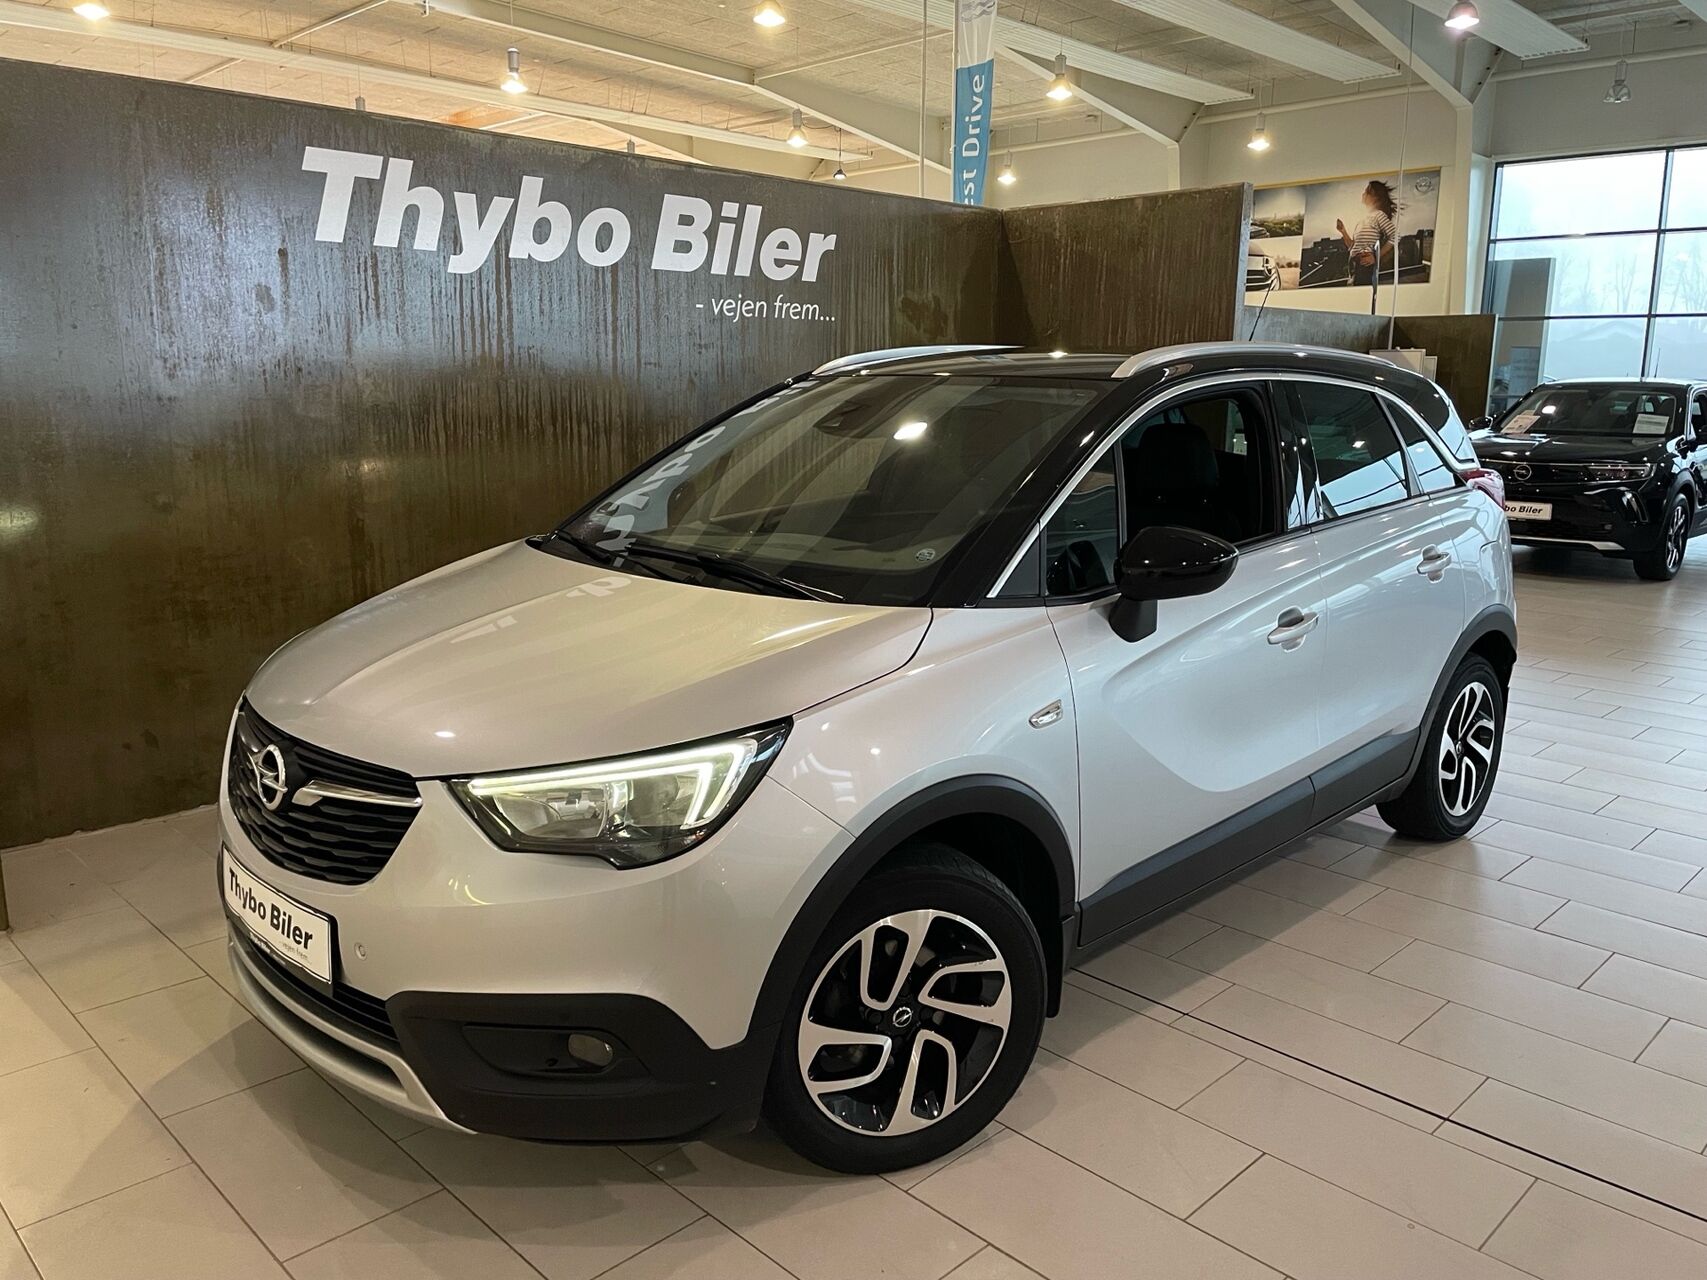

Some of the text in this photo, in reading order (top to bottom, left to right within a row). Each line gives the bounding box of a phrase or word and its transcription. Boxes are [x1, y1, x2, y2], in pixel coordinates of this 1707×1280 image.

[962, 74, 985, 157] Drive
[302, 146, 837, 283] Thybo Biler
[712, 296, 767, 322] vejen
[1519, 505, 1543, 513] Biler
[229, 867, 267, 920] Thybo
[270, 903, 313, 949] Biler
